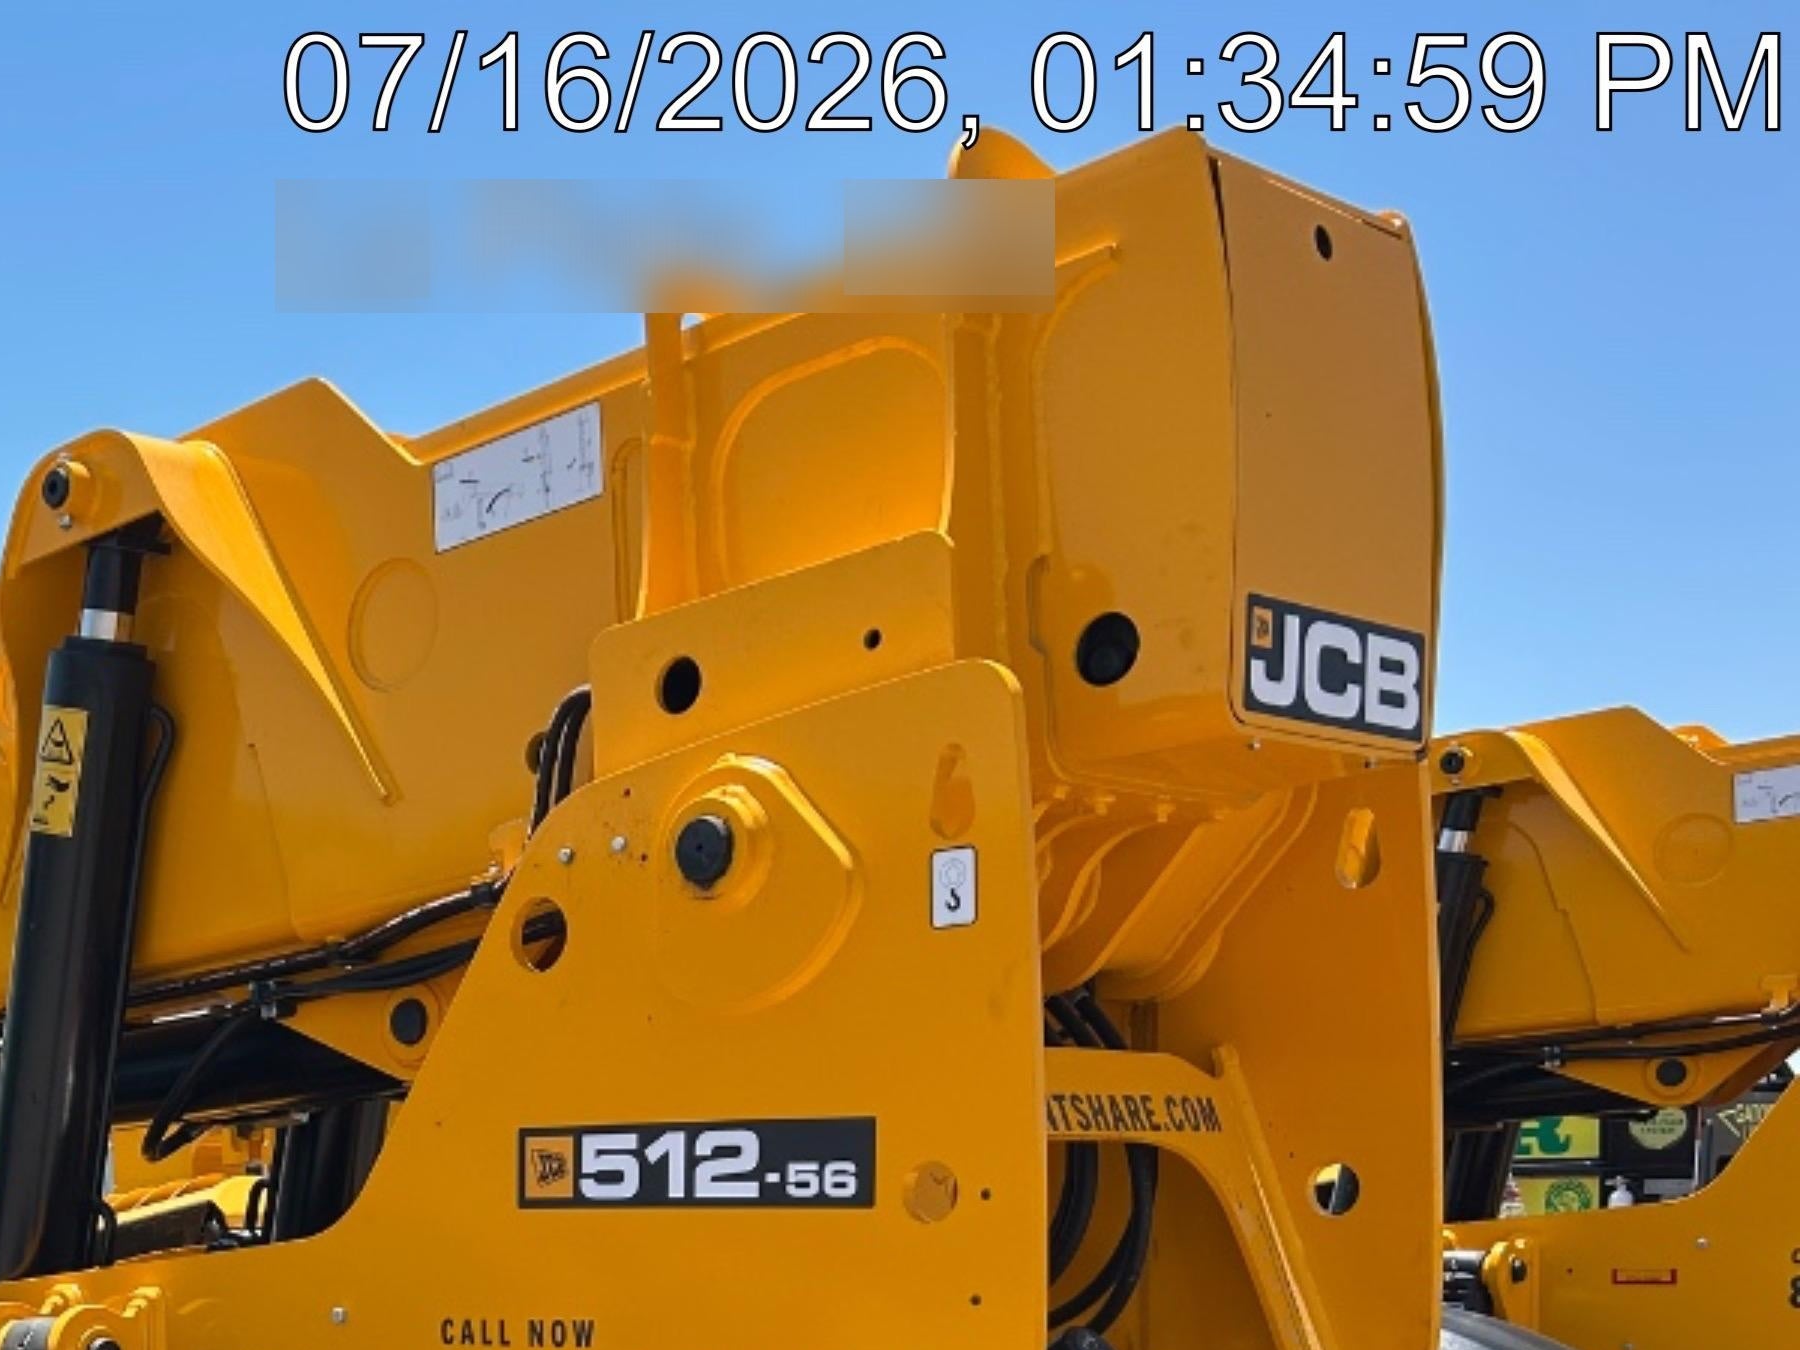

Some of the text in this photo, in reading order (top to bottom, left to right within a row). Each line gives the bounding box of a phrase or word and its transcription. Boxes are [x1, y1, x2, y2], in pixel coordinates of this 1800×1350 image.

[1250, 614, 1419, 730] JCB
[579, 1128, 858, 1202] 512-56
[441, 1318, 596, 1349] CALL NOW
